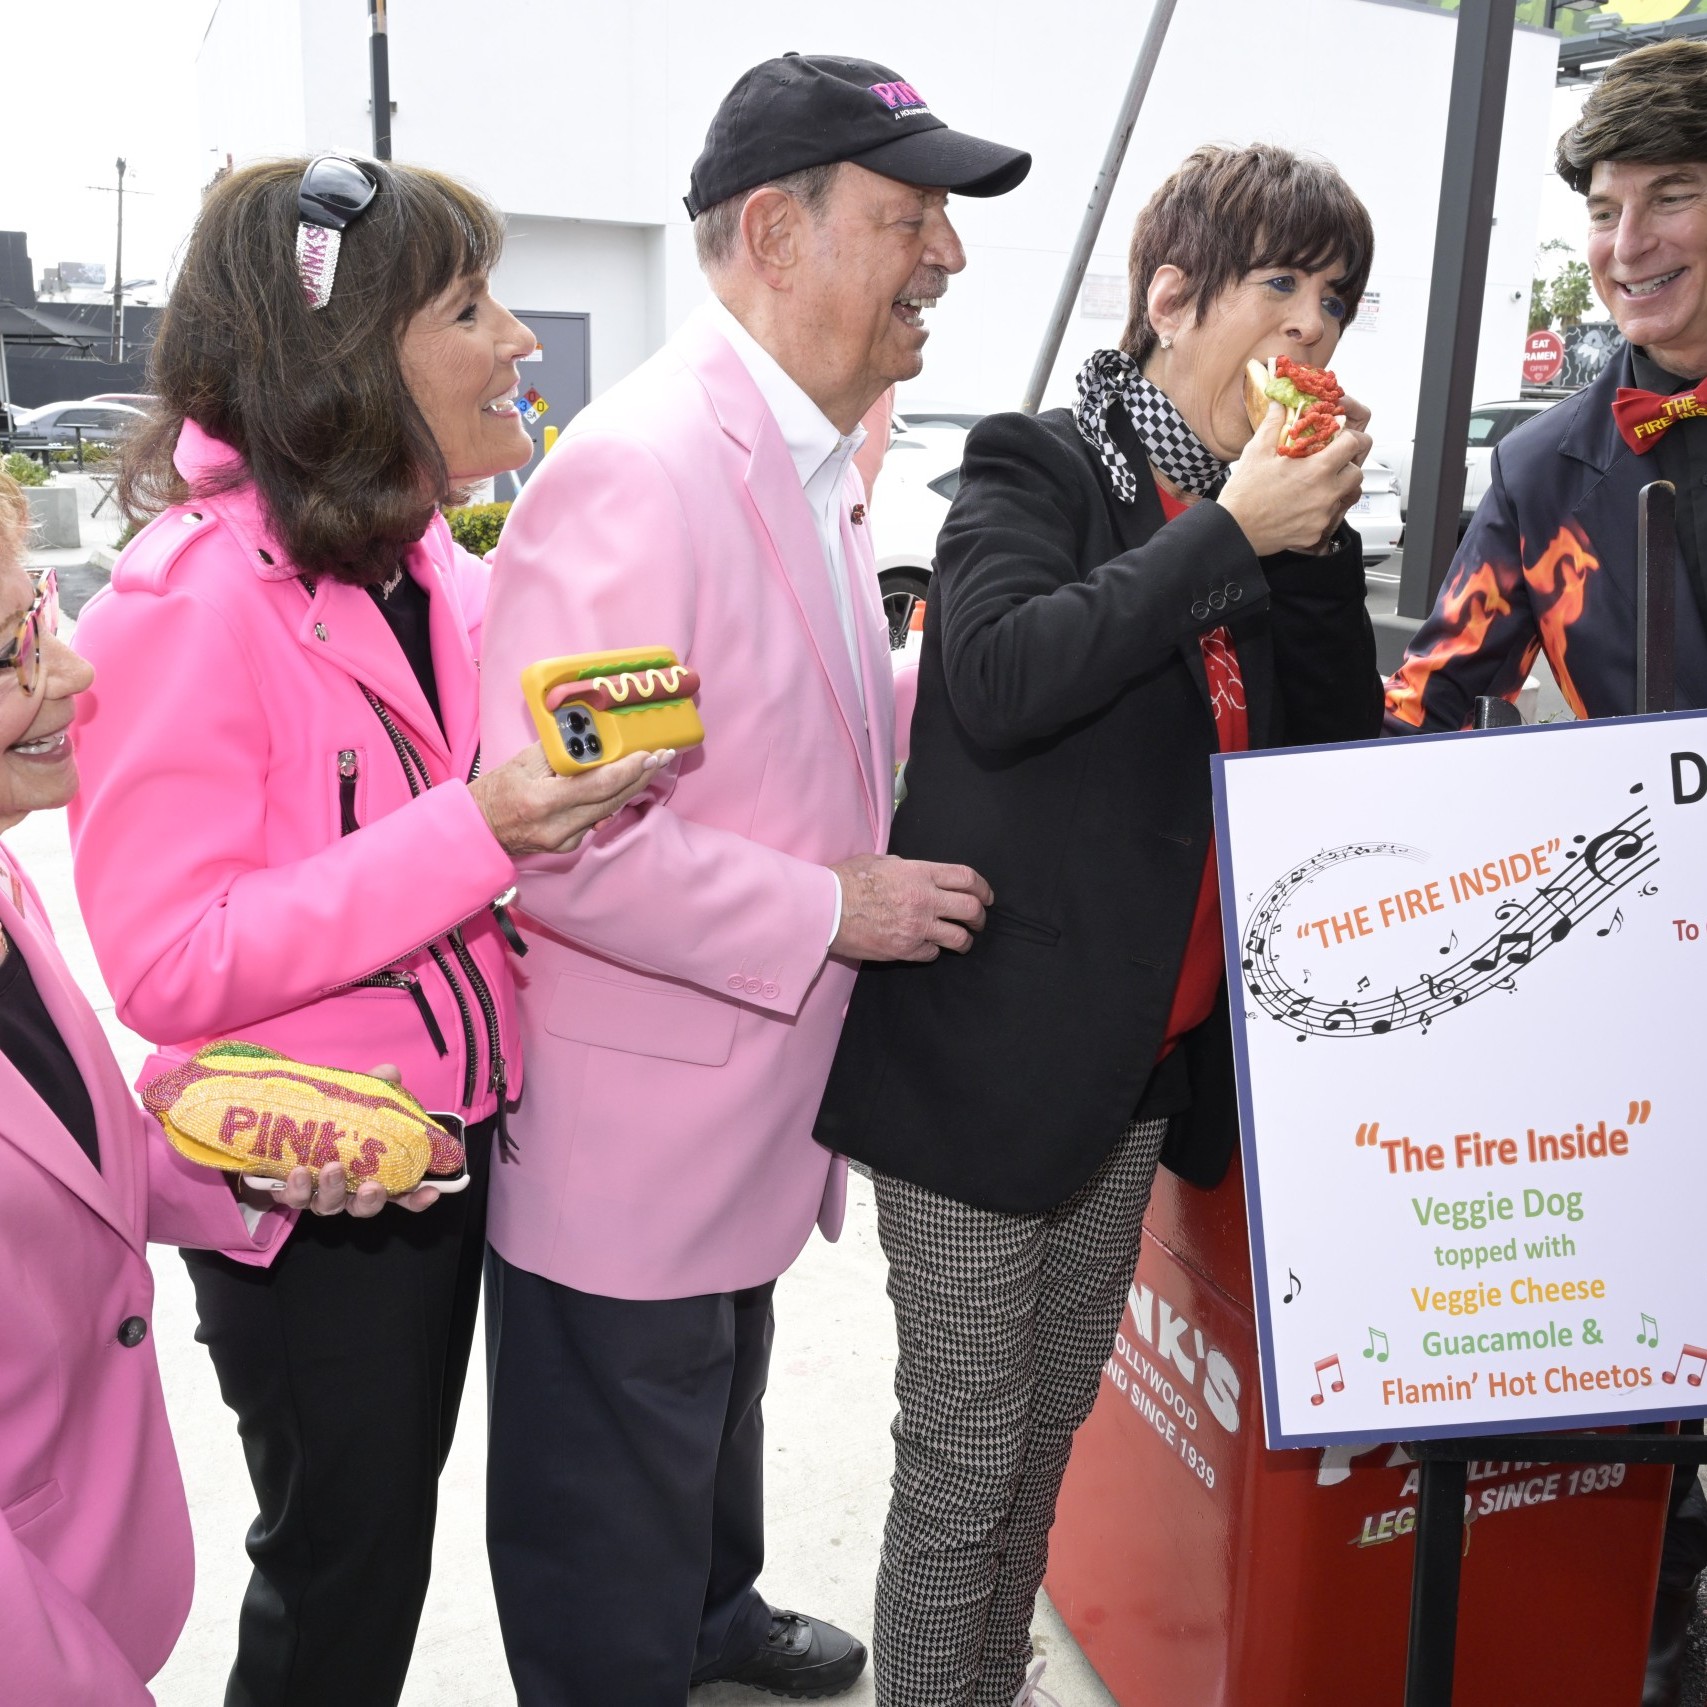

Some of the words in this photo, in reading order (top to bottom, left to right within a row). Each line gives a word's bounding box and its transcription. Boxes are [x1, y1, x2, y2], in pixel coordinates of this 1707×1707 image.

[1524, 351, 1557, 361] RAMEN
[1532, 339, 1550, 349] EAT
[519, 400, 527, 412] 3
[536, 401, 545, 412] 0
[528, 391, 536, 402] 0
[1661, 396, 1698, 416] THE
[1633, 416, 1672, 439] FIRE
[1671, 751, 1707, 805] D
[1297, 906, 1374, 949] “THE
[1378, 881, 1445, 928] FIRE
[1449, 838, 1561, 904] INSIDE”
[1672, 919, 1699, 941] To
[218, 1104, 387, 1176] PINK'S
[1355, 1122, 1444, 1174] “The
[1455, 1128, 1518, 1169] Fire
[1527, 1100, 1652, 1164] Inside”
[1411, 1191, 1514, 1231] Veggie
[1523, 1188, 1585, 1222] Dog
[1433, 1238, 1517, 1270] topped
[1524, 1234, 1576, 1260] with
[1410, 1281, 1503, 1316] Veggie
[1510, 1277, 1606, 1307] Cheese
[1422, 1320, 1573, 1357] Guacamole
[1582, 1318, 1604, 1345] &
[1115, 1333, 1197, 1430] OLLYWOOD
[1488, 1371, 1538, 1398] Hot
[1545, 1364, 1653, 1394] Cheetos
[1103, 1357, 1128, 1391] ND
[1131, 1383, 1176, 1446] SINCE
[1180, 1438, 1215, 1489] 1939
[1478, 1473, 1561, 1515] SINCE
[1568, 1462, 1626, 1496] 1939
